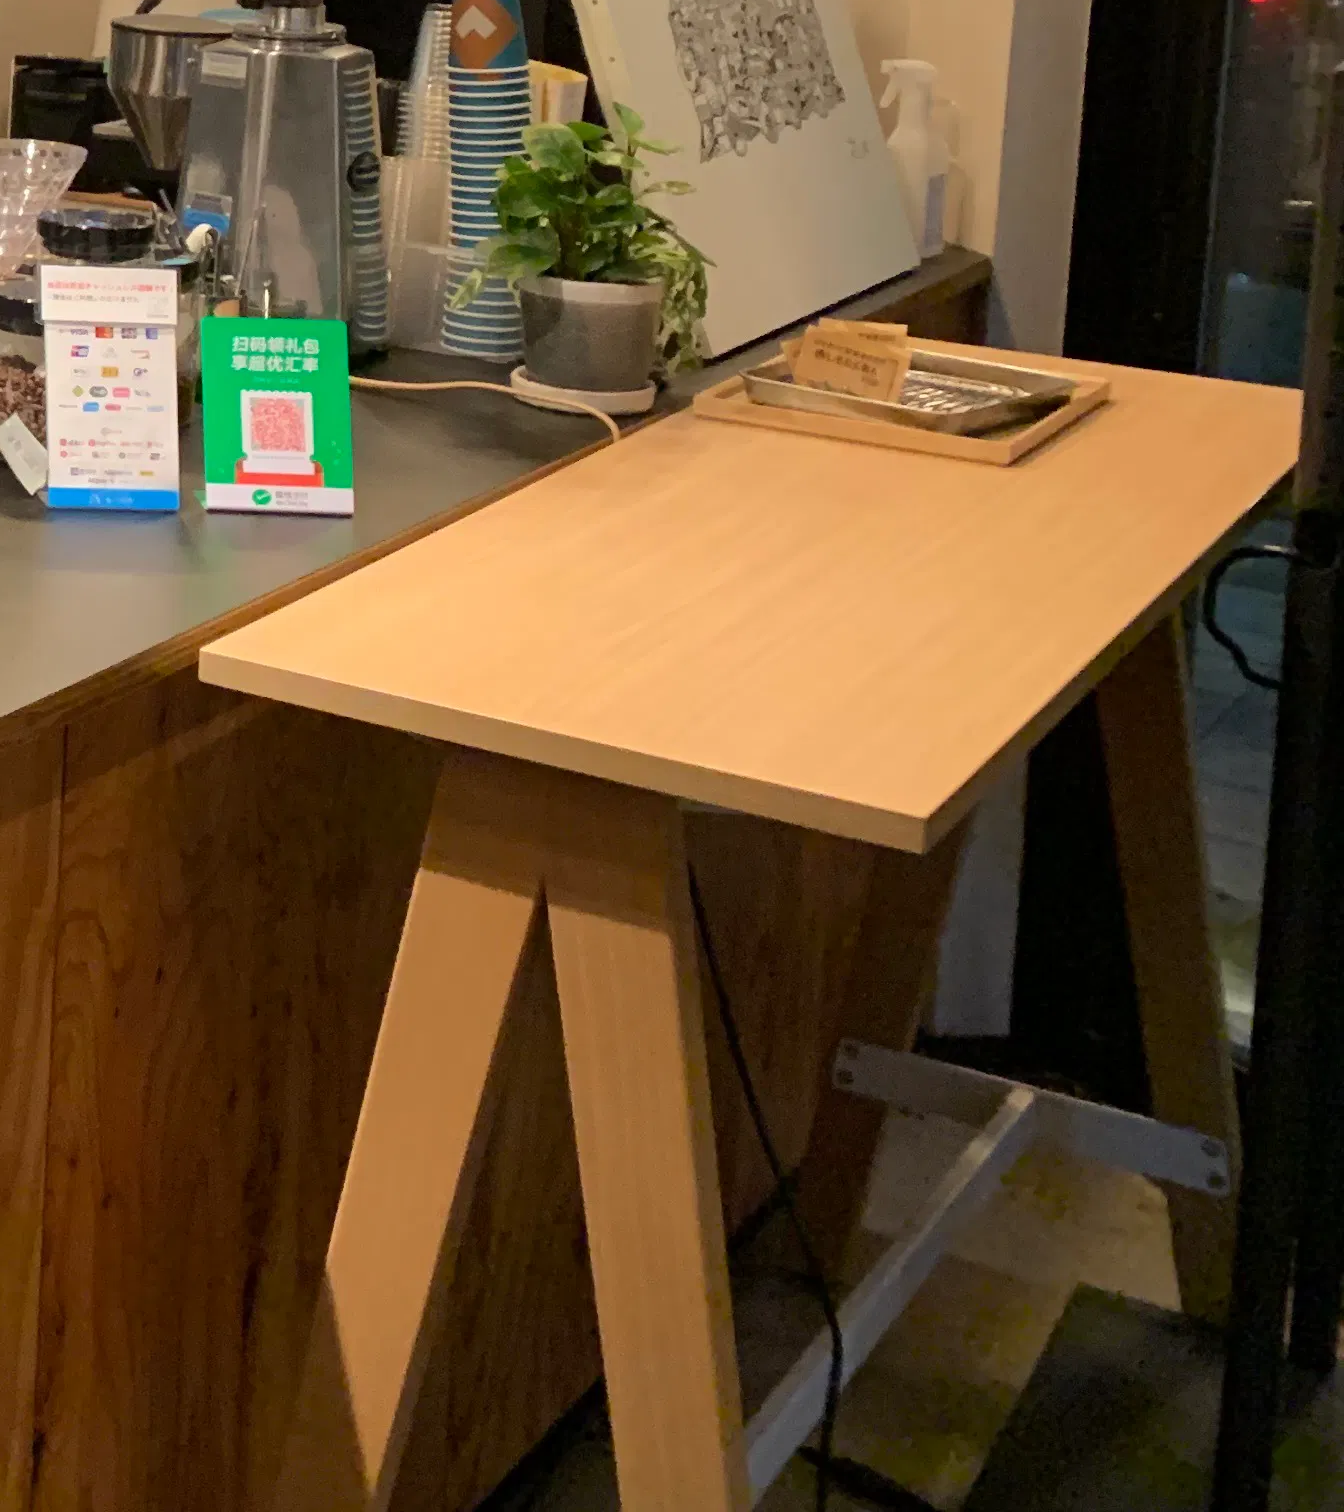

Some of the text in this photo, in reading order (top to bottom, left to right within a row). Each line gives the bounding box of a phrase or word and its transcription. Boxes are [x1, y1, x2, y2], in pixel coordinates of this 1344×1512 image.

[232, 336, 320, 355] 扫码领礼包
[231, 355, 319, 373] 享超优汇率
